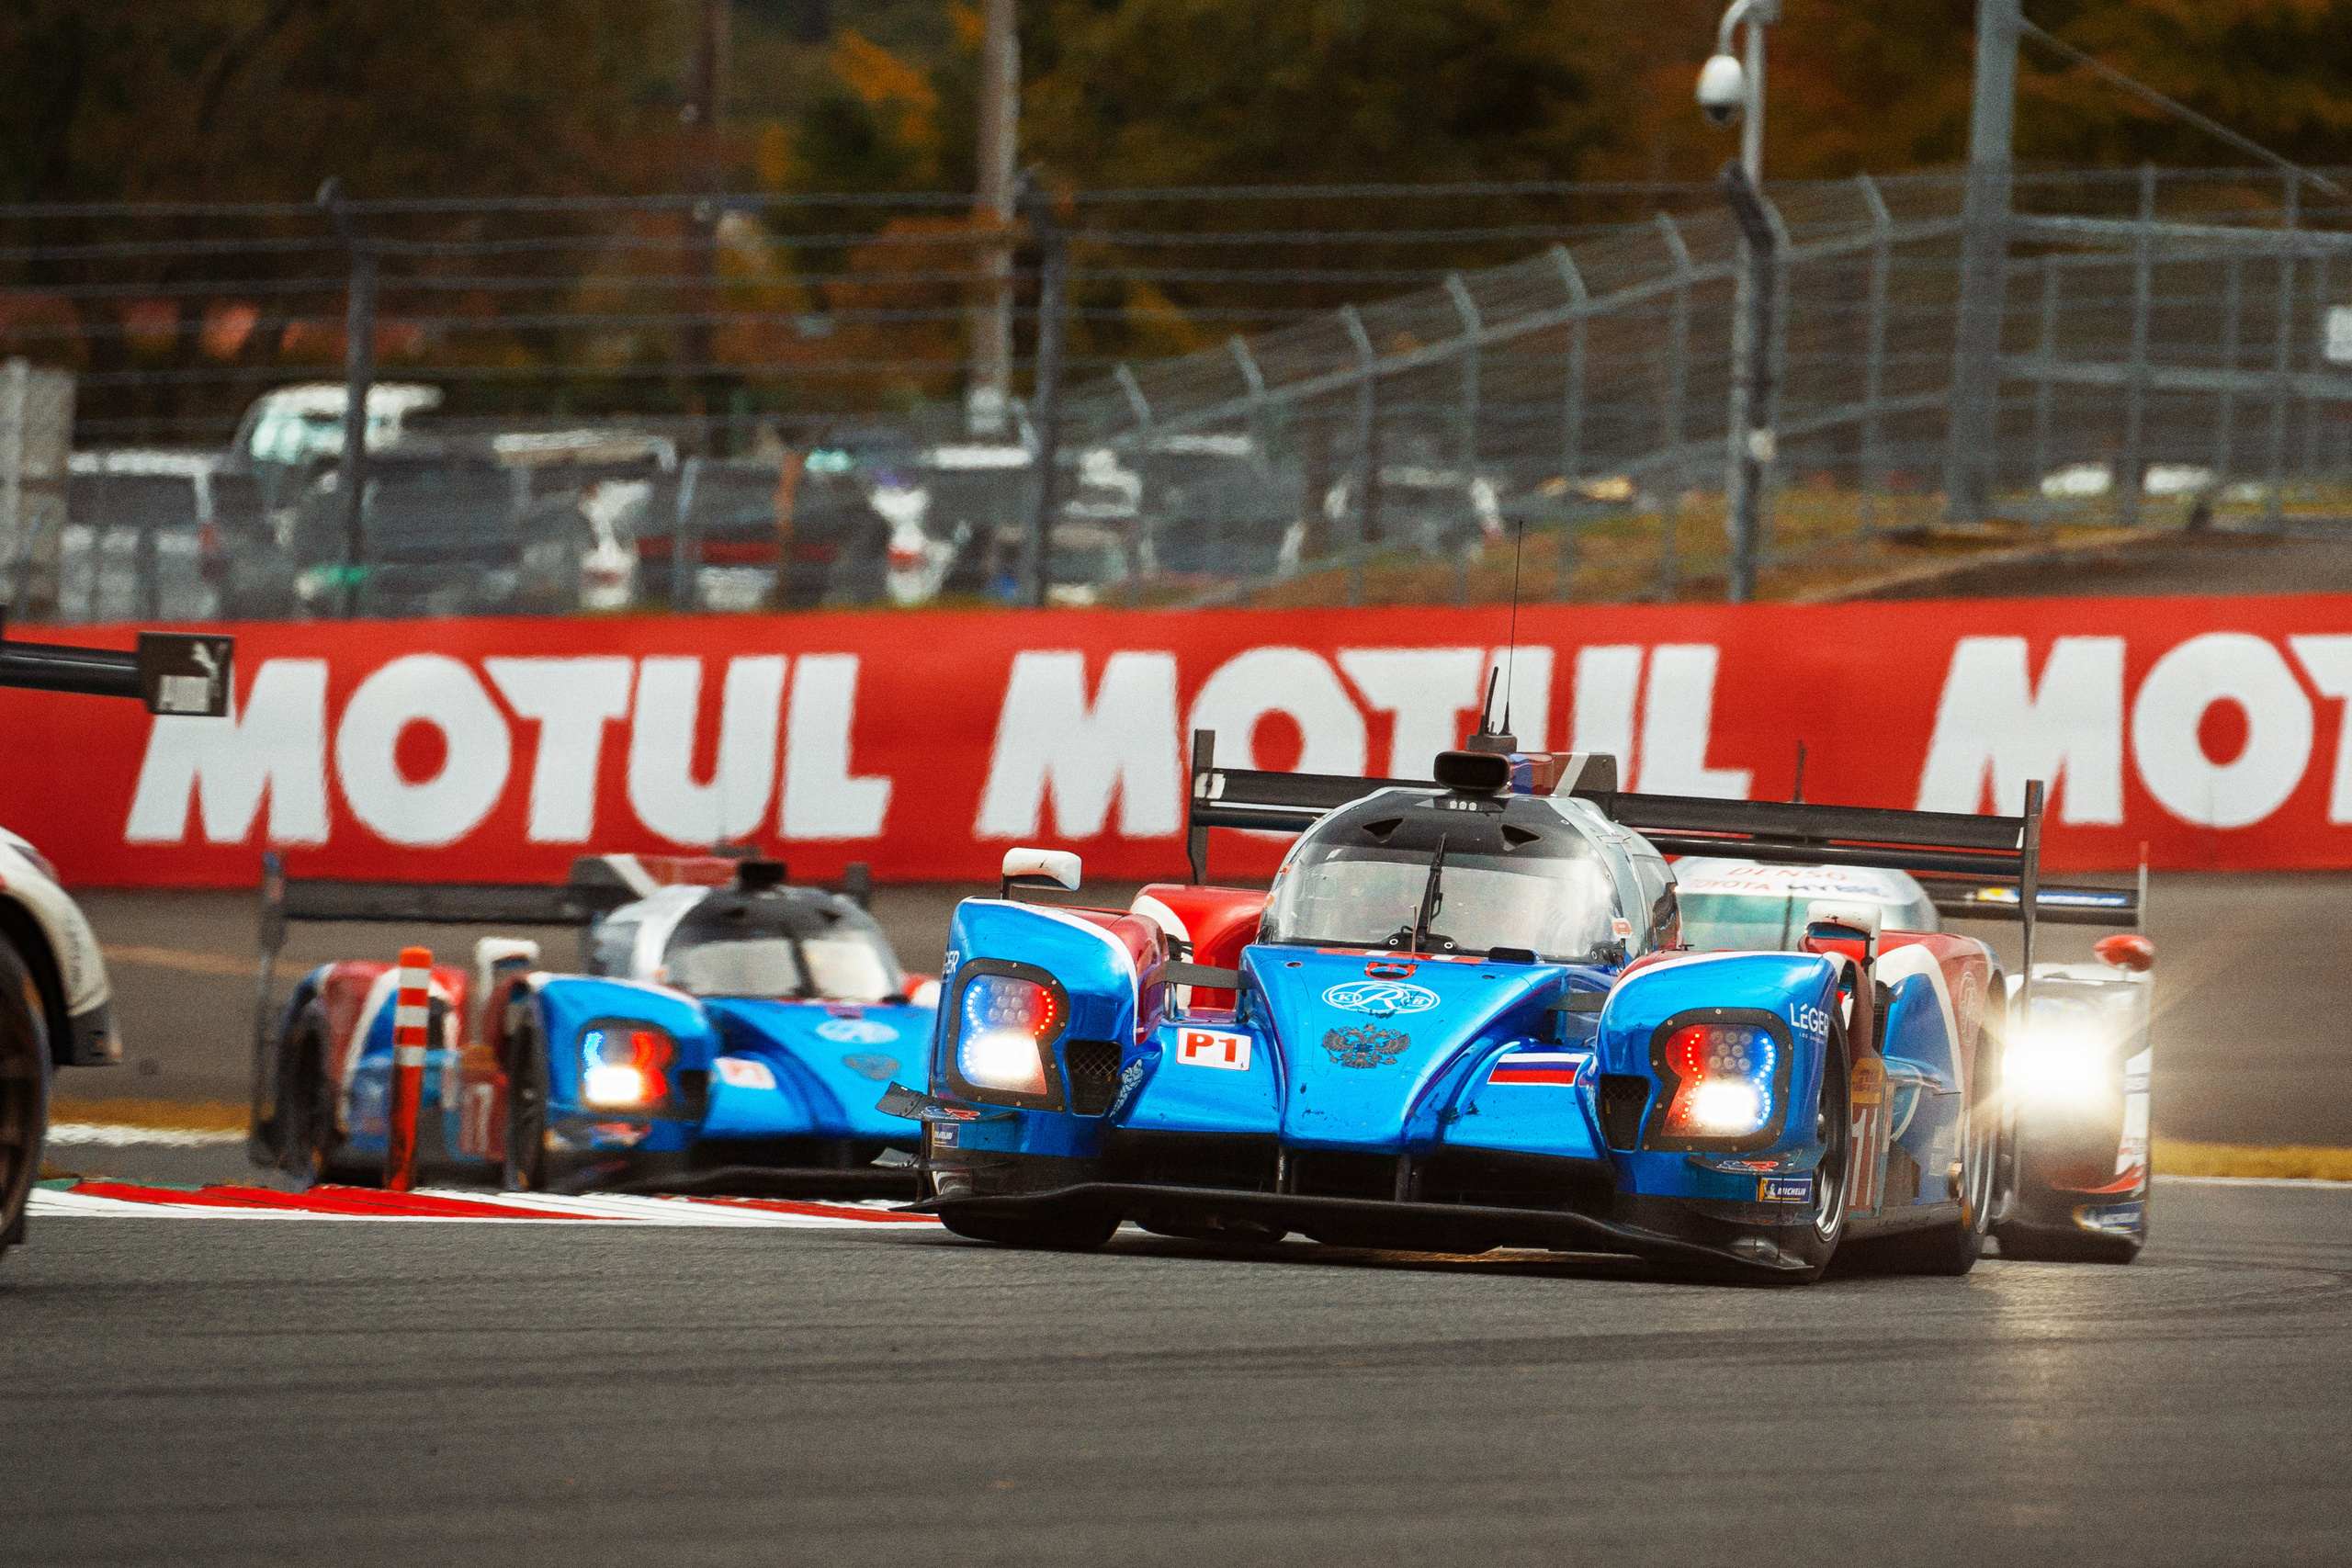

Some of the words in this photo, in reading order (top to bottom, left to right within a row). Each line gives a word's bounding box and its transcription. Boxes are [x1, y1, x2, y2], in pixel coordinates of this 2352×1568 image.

[124, 652, 892, 848] MOTUL
[974, 645, 1753, 841] MOTUL
[1689, 878, 1770, 891] TOYOTA
[1727, 866, 1847, 882] DENSO
[1790, 1002, 1829, 1038] LÉGER
[1184, 1032, 1238, 1063] P1
[1849, 1107, 1879, 1206] 11
[1777, 1187, 1807, 1196] MICHELIN
